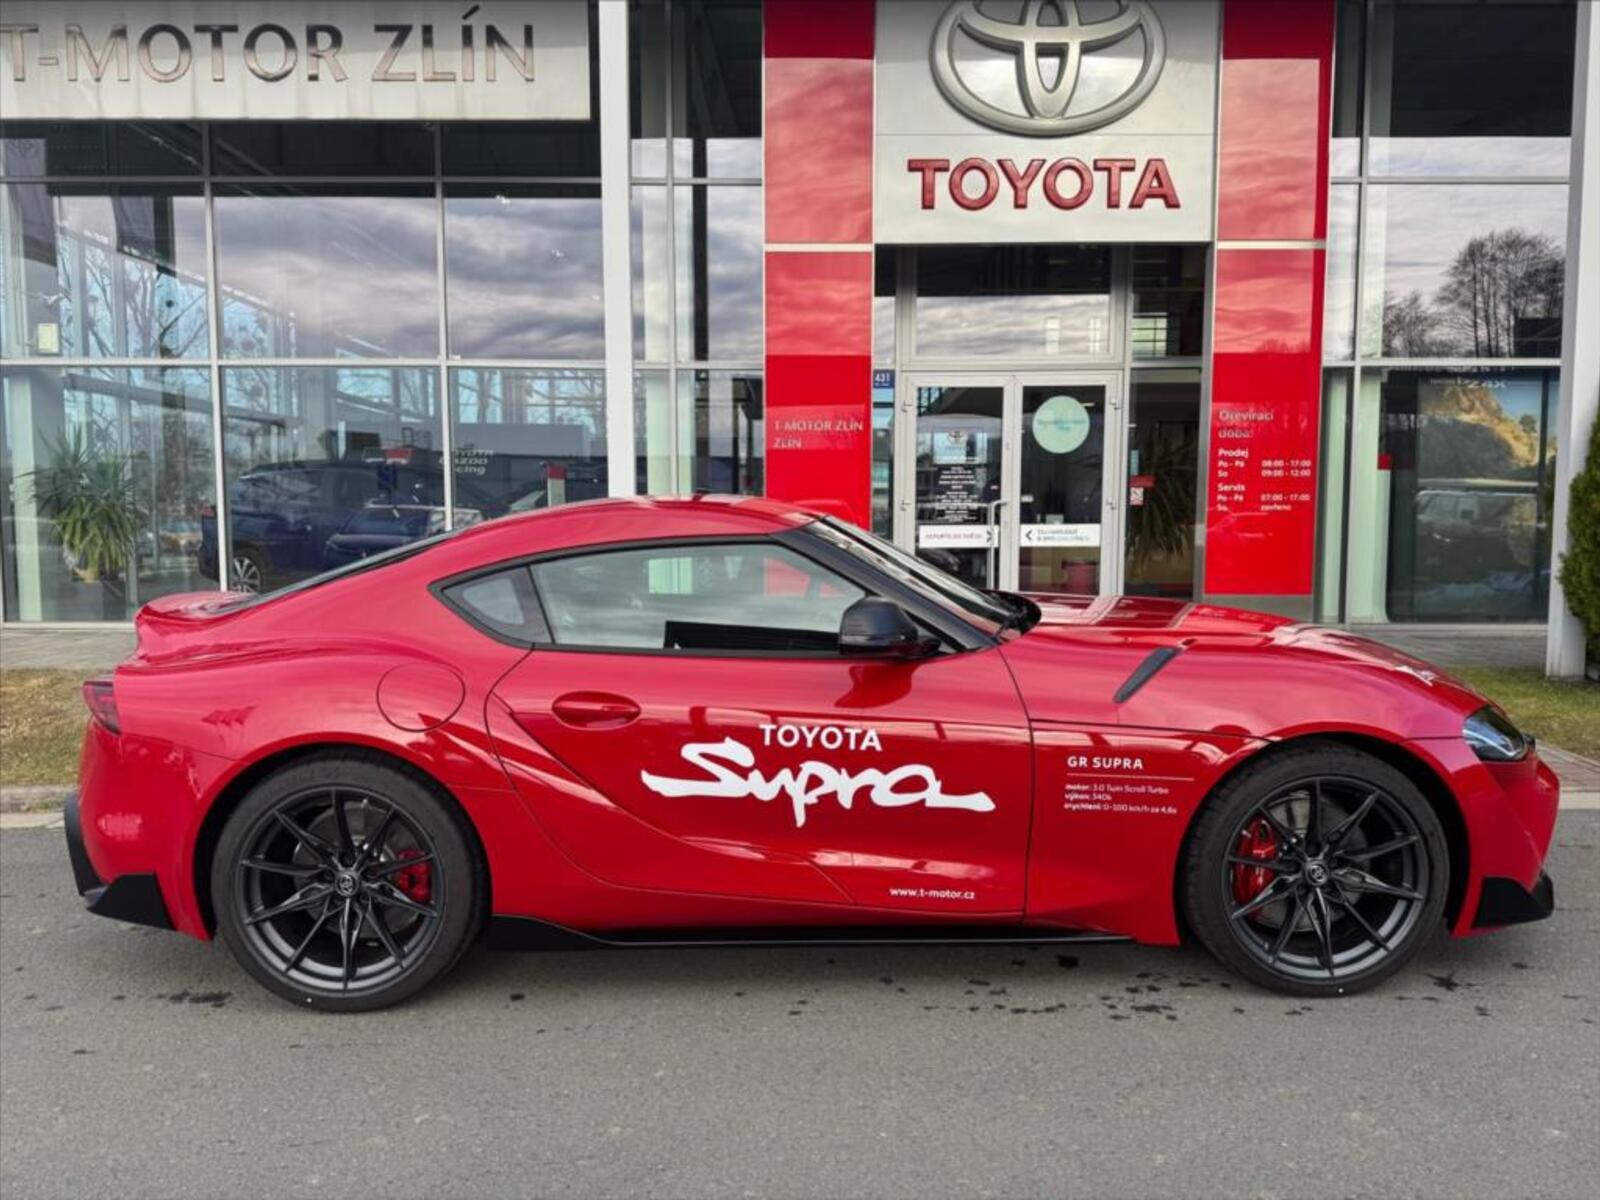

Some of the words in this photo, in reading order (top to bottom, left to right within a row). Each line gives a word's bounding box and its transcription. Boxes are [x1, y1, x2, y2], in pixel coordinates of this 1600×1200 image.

[0, 23, 348, 82] T-MOTOR
[371, 5, 535, 82] ZLÍN
[907, 157, 1181, 211] TOYOTA
[1218, 448, 1249, 458] Prodej
[1217, 483, 1245, 491] Servis
[759, 723, 882, 751] TOYOTA
[1067, 756, 1088, 768] GR
[1092, 756, 1144, 769] SUPRA
[641, 736, 996, 828] Supra
[889, 886, 976, 899] www.t-motor.cz
